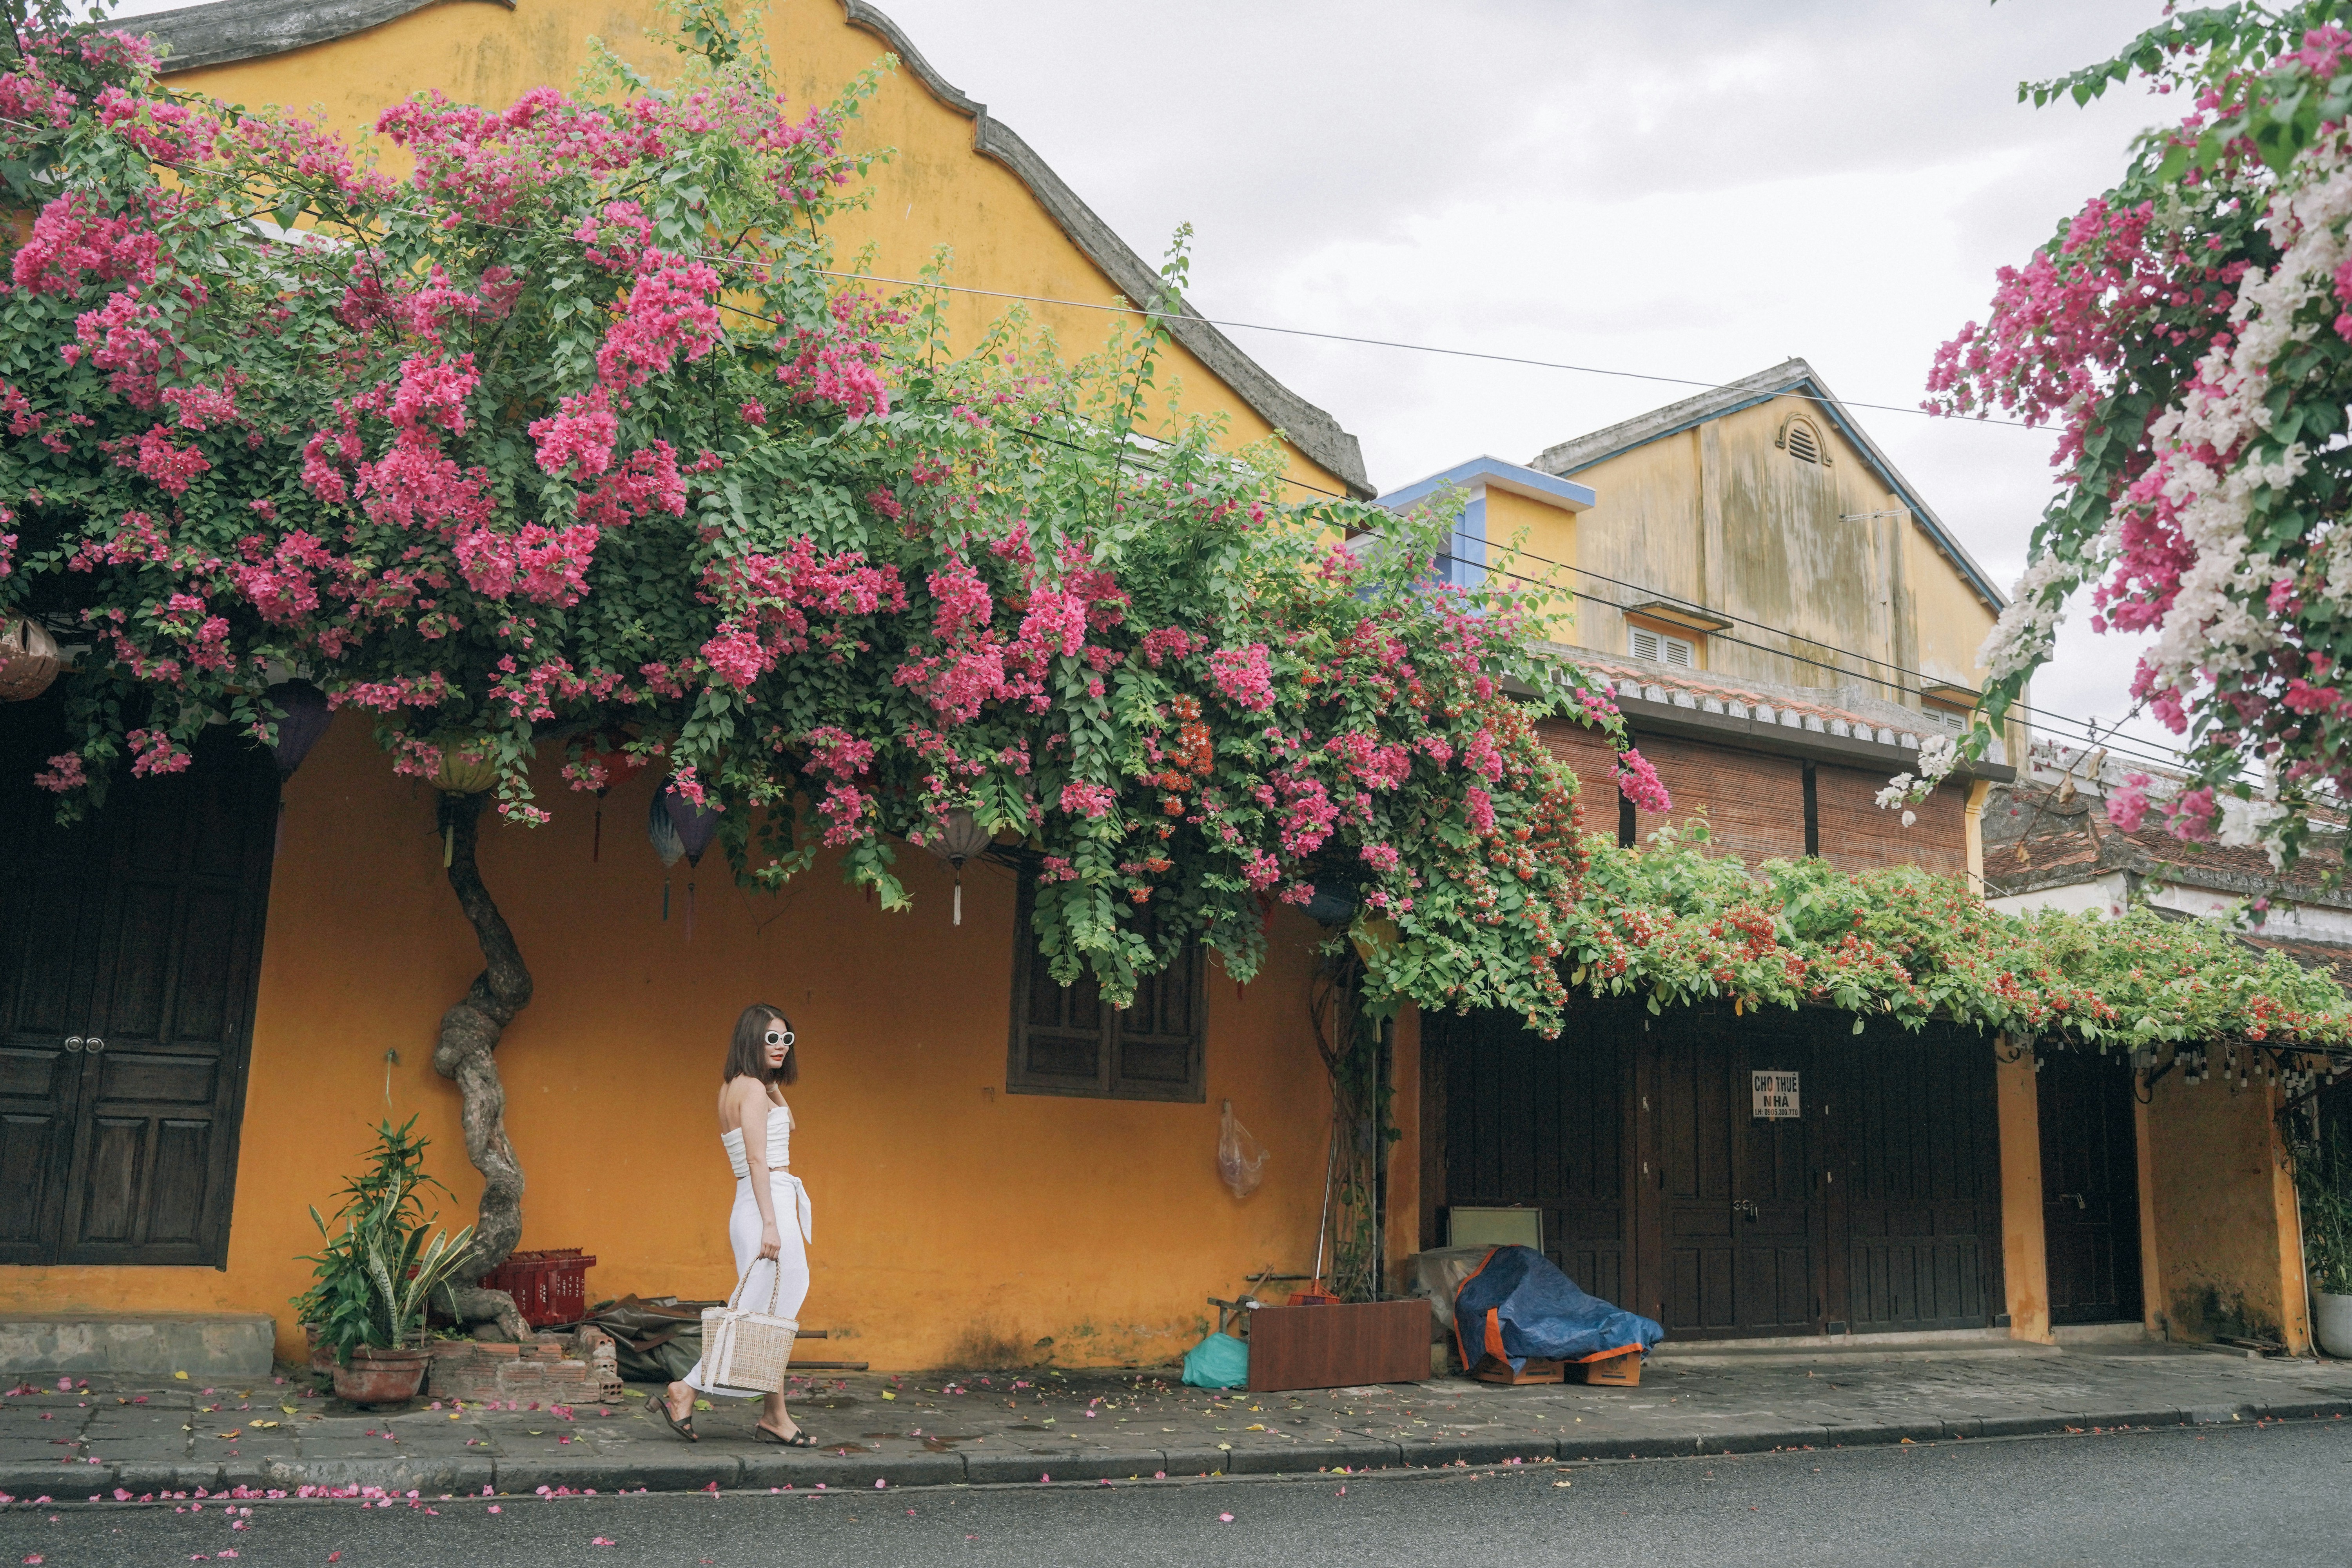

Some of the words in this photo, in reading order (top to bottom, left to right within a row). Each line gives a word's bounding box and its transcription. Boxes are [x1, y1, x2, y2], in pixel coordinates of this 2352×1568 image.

[1755, 1076, 1773, 1092] CHO
[1776, 1073, 1797, 1092] THUÊ
[1764, 1093, 1789, 1107] NHÀ
